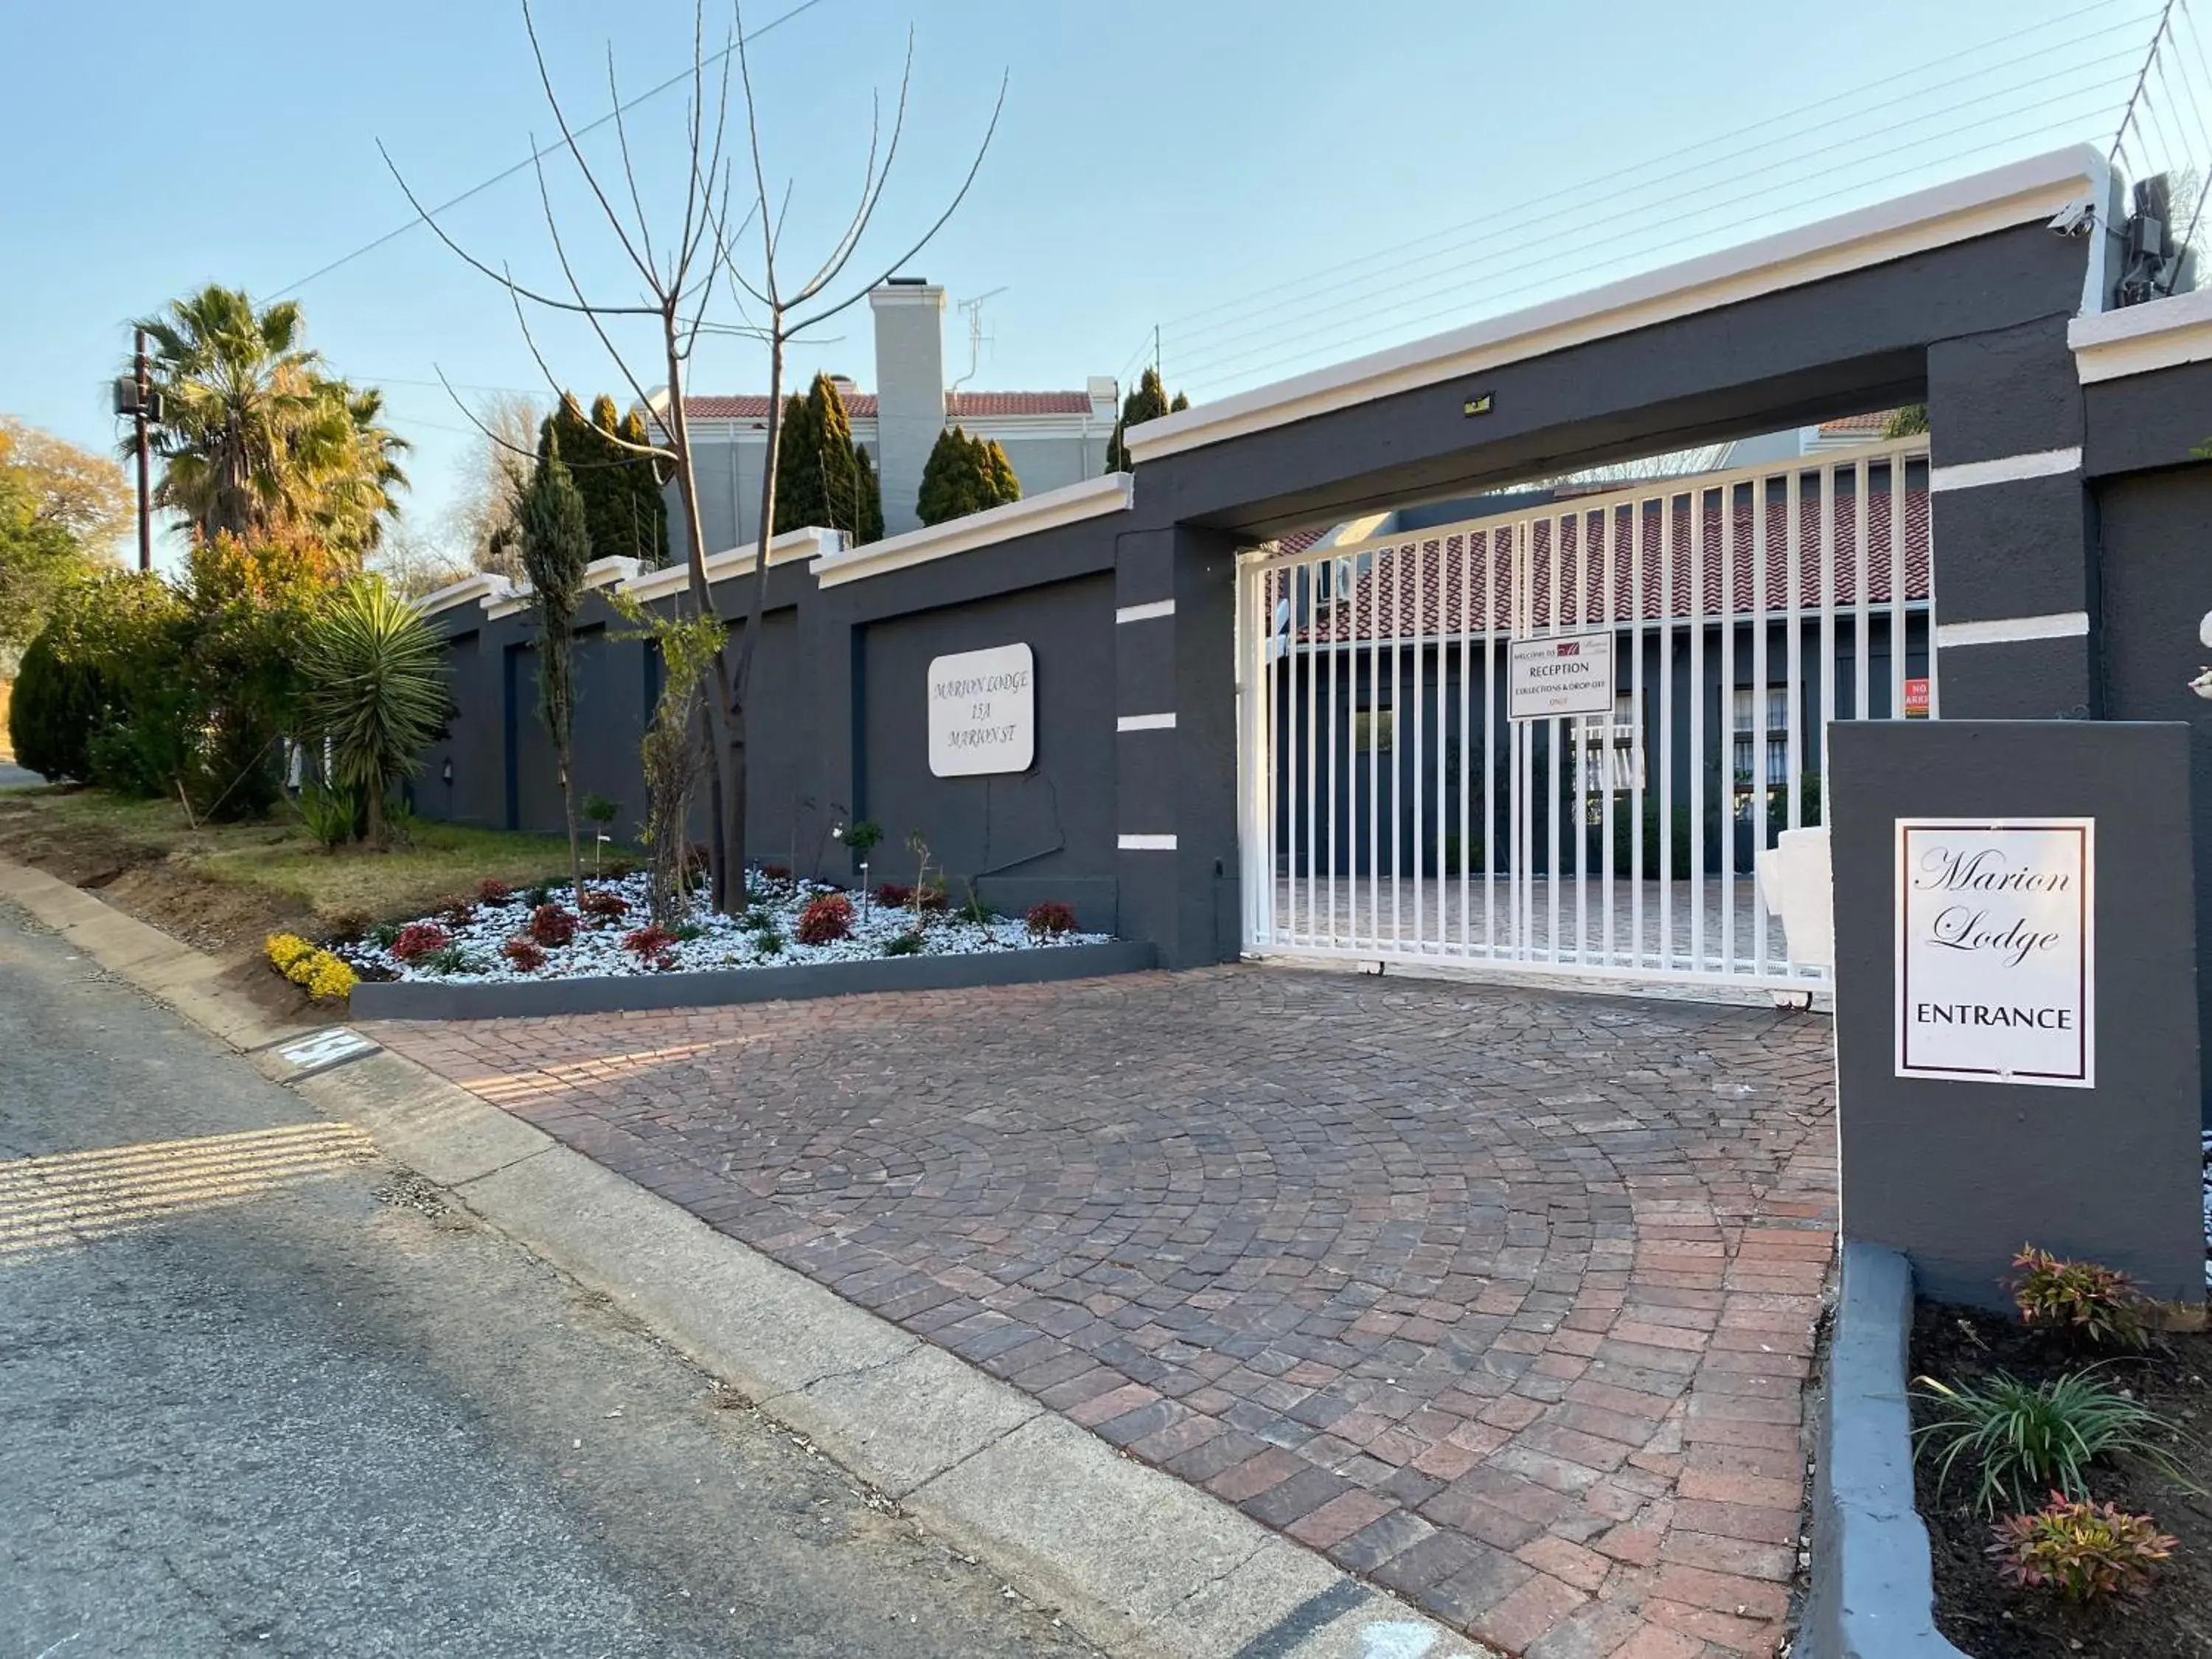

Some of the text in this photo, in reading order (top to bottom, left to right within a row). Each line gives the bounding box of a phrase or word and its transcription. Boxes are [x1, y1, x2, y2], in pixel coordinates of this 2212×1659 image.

[1530, 663, 1590, 677] RECEPTION
[933, 670, 1029, 700] MARION LODGE
[1912, 684, 1927, 694] NO
[971, 702, 991, 720] 15A
[948, 725, 1017, 748] MARION ST
[1914, 846, 2070, 892] Marion
[1924, 905, 2060, 968] Lodge
[1917, 1003, 2073, 1030] ENTRANCE
